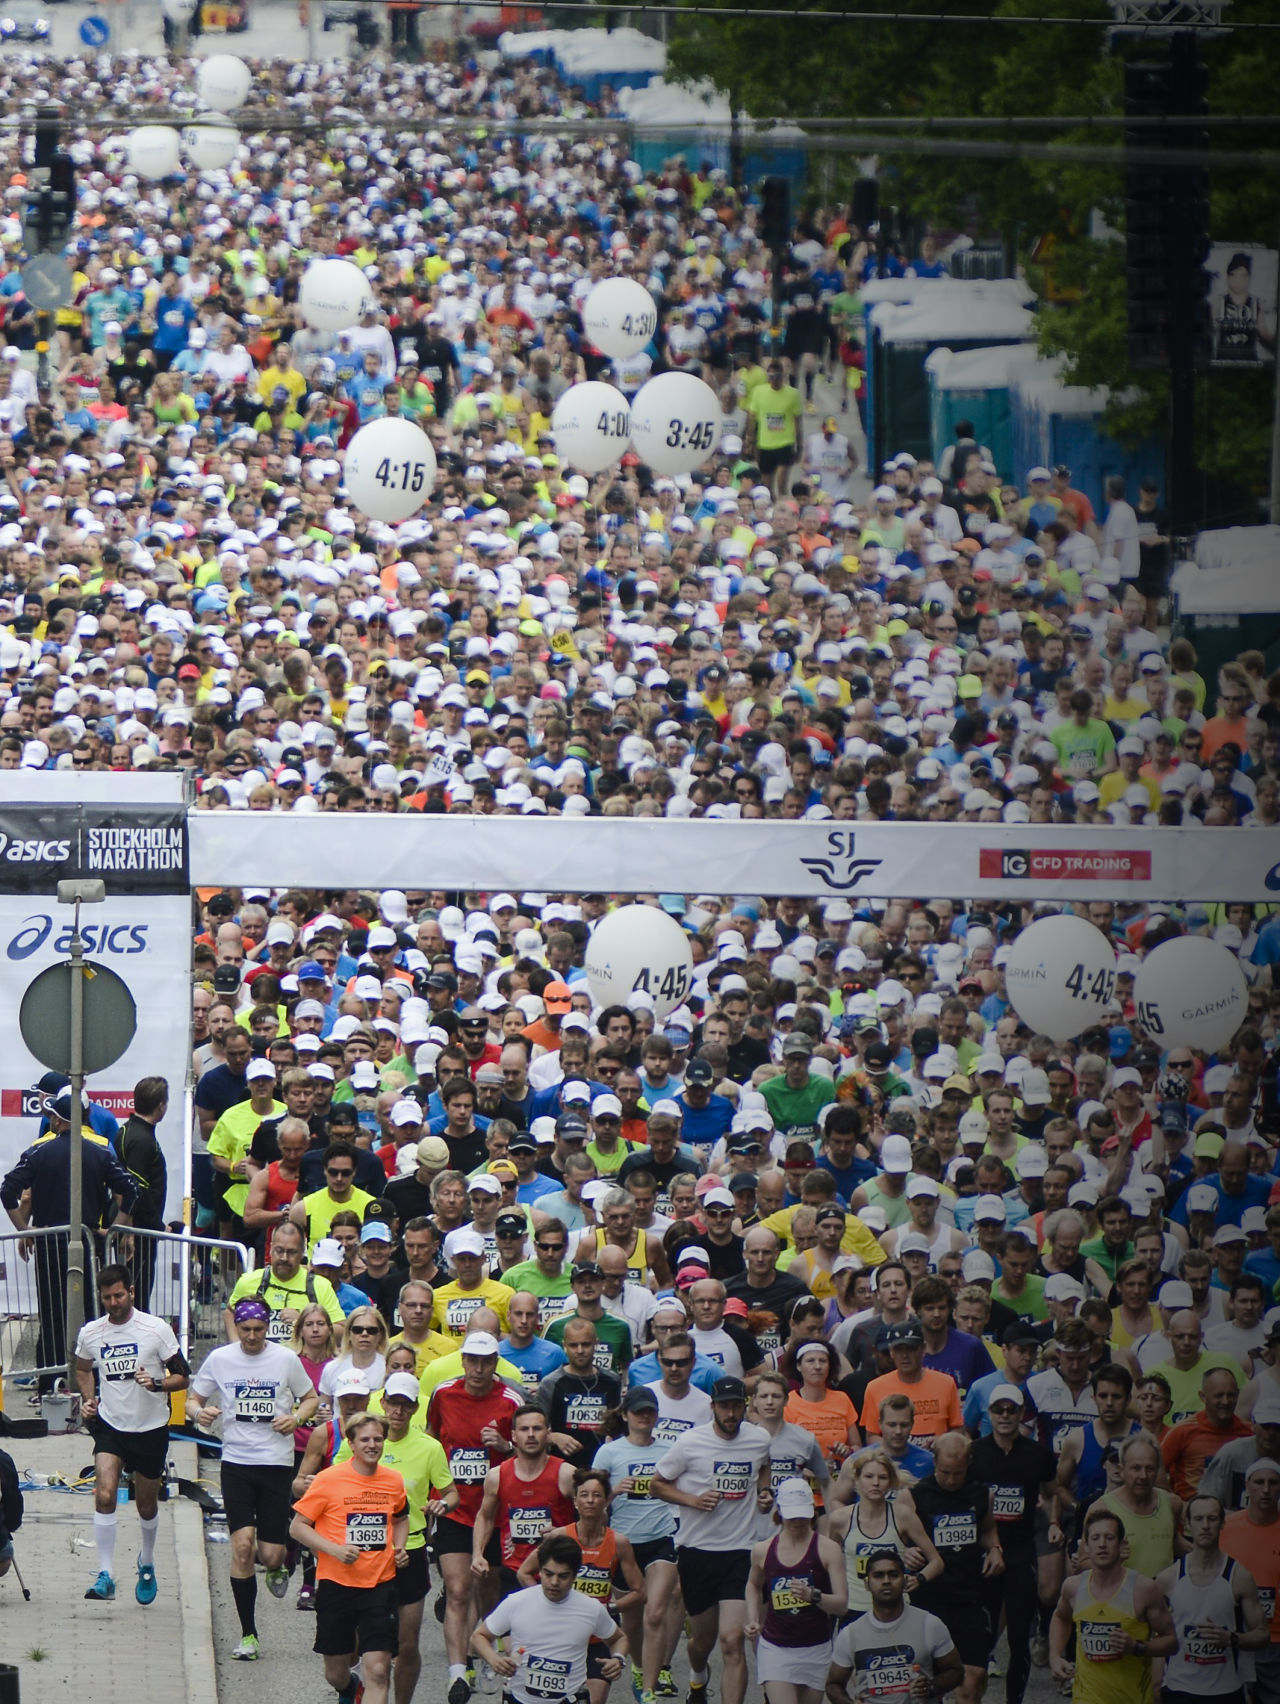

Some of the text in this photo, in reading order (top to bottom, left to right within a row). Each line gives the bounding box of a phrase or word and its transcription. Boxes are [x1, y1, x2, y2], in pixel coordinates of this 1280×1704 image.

[621, 312, 655, 336] 4:30
[666, 419, 715, 451] 3:45
[375, 457, 426, 492] 4:15
[88, 827, 183, 849] STOCKHOLM
[828, 831, 856, 859] SJ
[88, 848, 183, 870] MARATHON
[1002, 854, 1131, 876] IG CFD TRADING
[1066, 962, 1116, 1006] 4:45
[1182, 993, 1240, 1021] GARMIN
[105, 1358, 137, 1372] 11027
[238, 1402, 273, 1414] 11460
[453, 1464, 487, 1476] 10613
[715, 1477, 749, 1490] 10500
[349, 1529, 384, 1542] 13693
[937, 1530, 974, 1544] 13984
[573, 1580, 608, 1594] 14834
[1083, 1639, 1111, 1652] 1100
[528, 1673, 566, 1690] 11693
[871, 1668, 911, 1685] 19645
